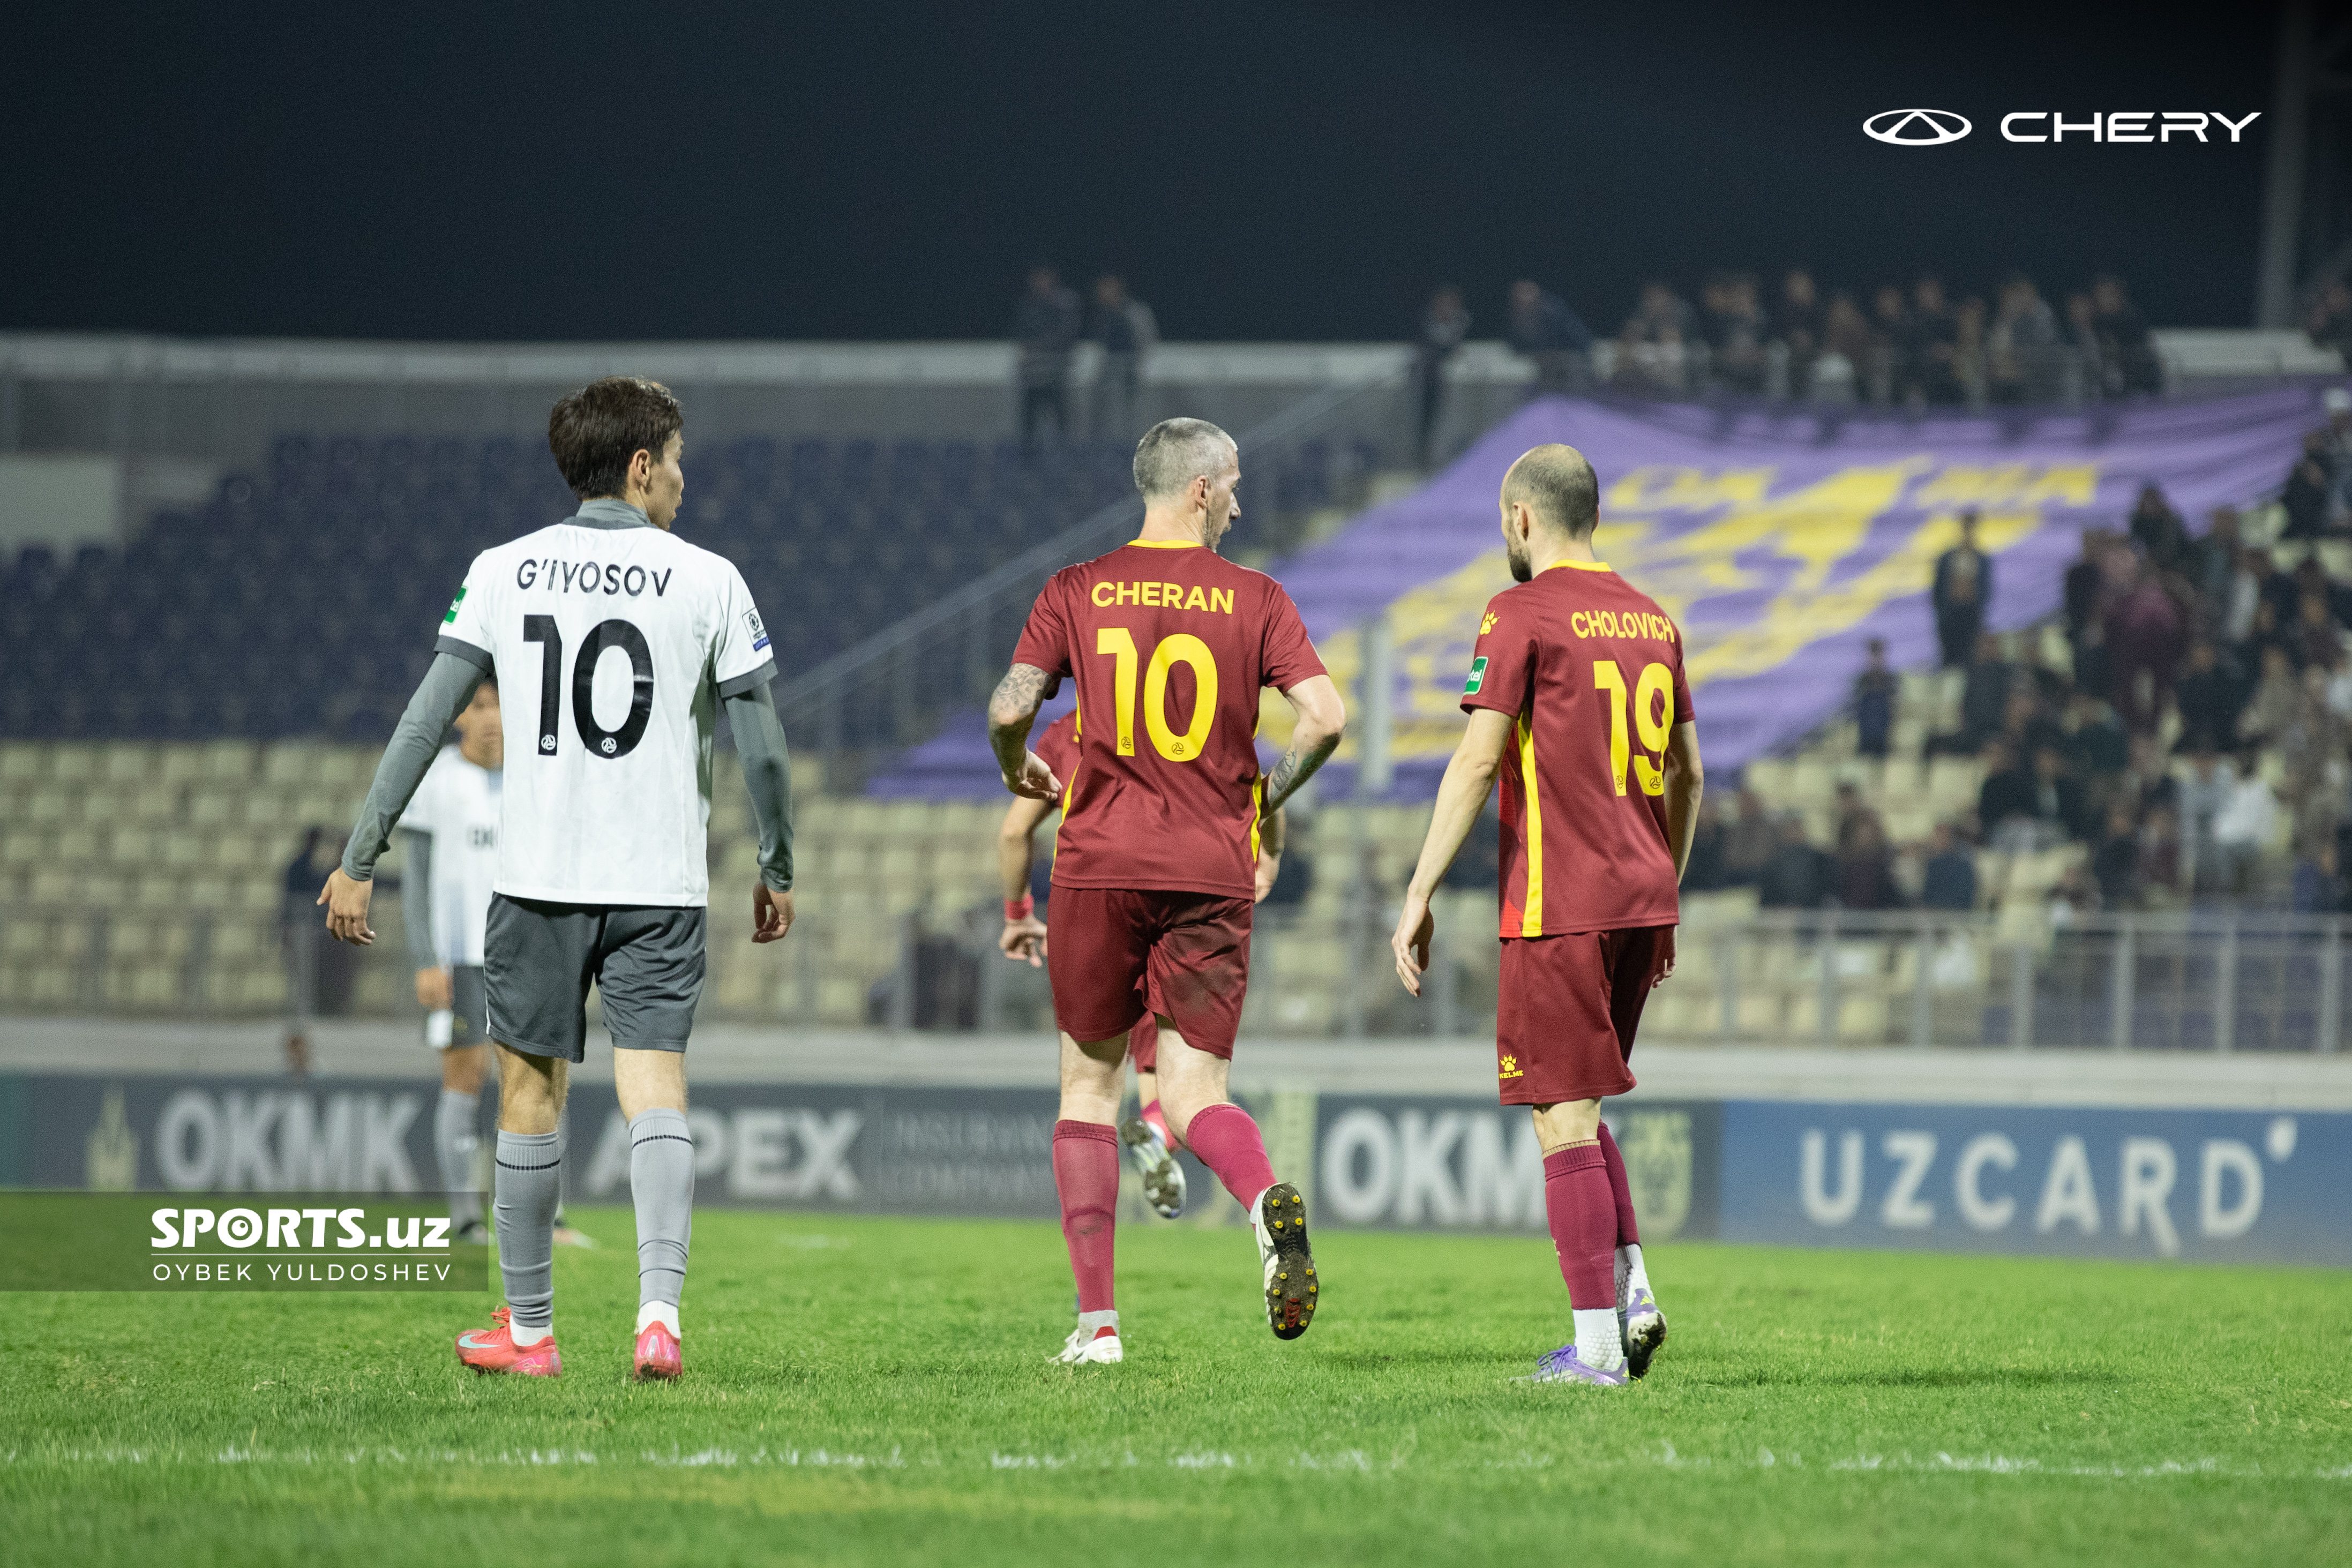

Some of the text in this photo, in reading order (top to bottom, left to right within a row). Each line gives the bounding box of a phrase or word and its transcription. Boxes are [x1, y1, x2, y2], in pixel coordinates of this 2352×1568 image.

[516, 558, 672, 597] G'IYOSOV
[1091, 581, 1234, 614] CHERAN
[1571, 610, 1675, 643] CHOLOVICH
[523, 614, 655, 760] 10
[1097, 627, 1218, 762] 10
[1593, 660, 1675, 797] 19
[1499, 1070, 1524, 1079] KELME
[154, 1089, 426, 1192] OKMK
[1322, 1108, 1615, 1224] OKM
[1799, 1128, 2266, 1257] UZCARD
